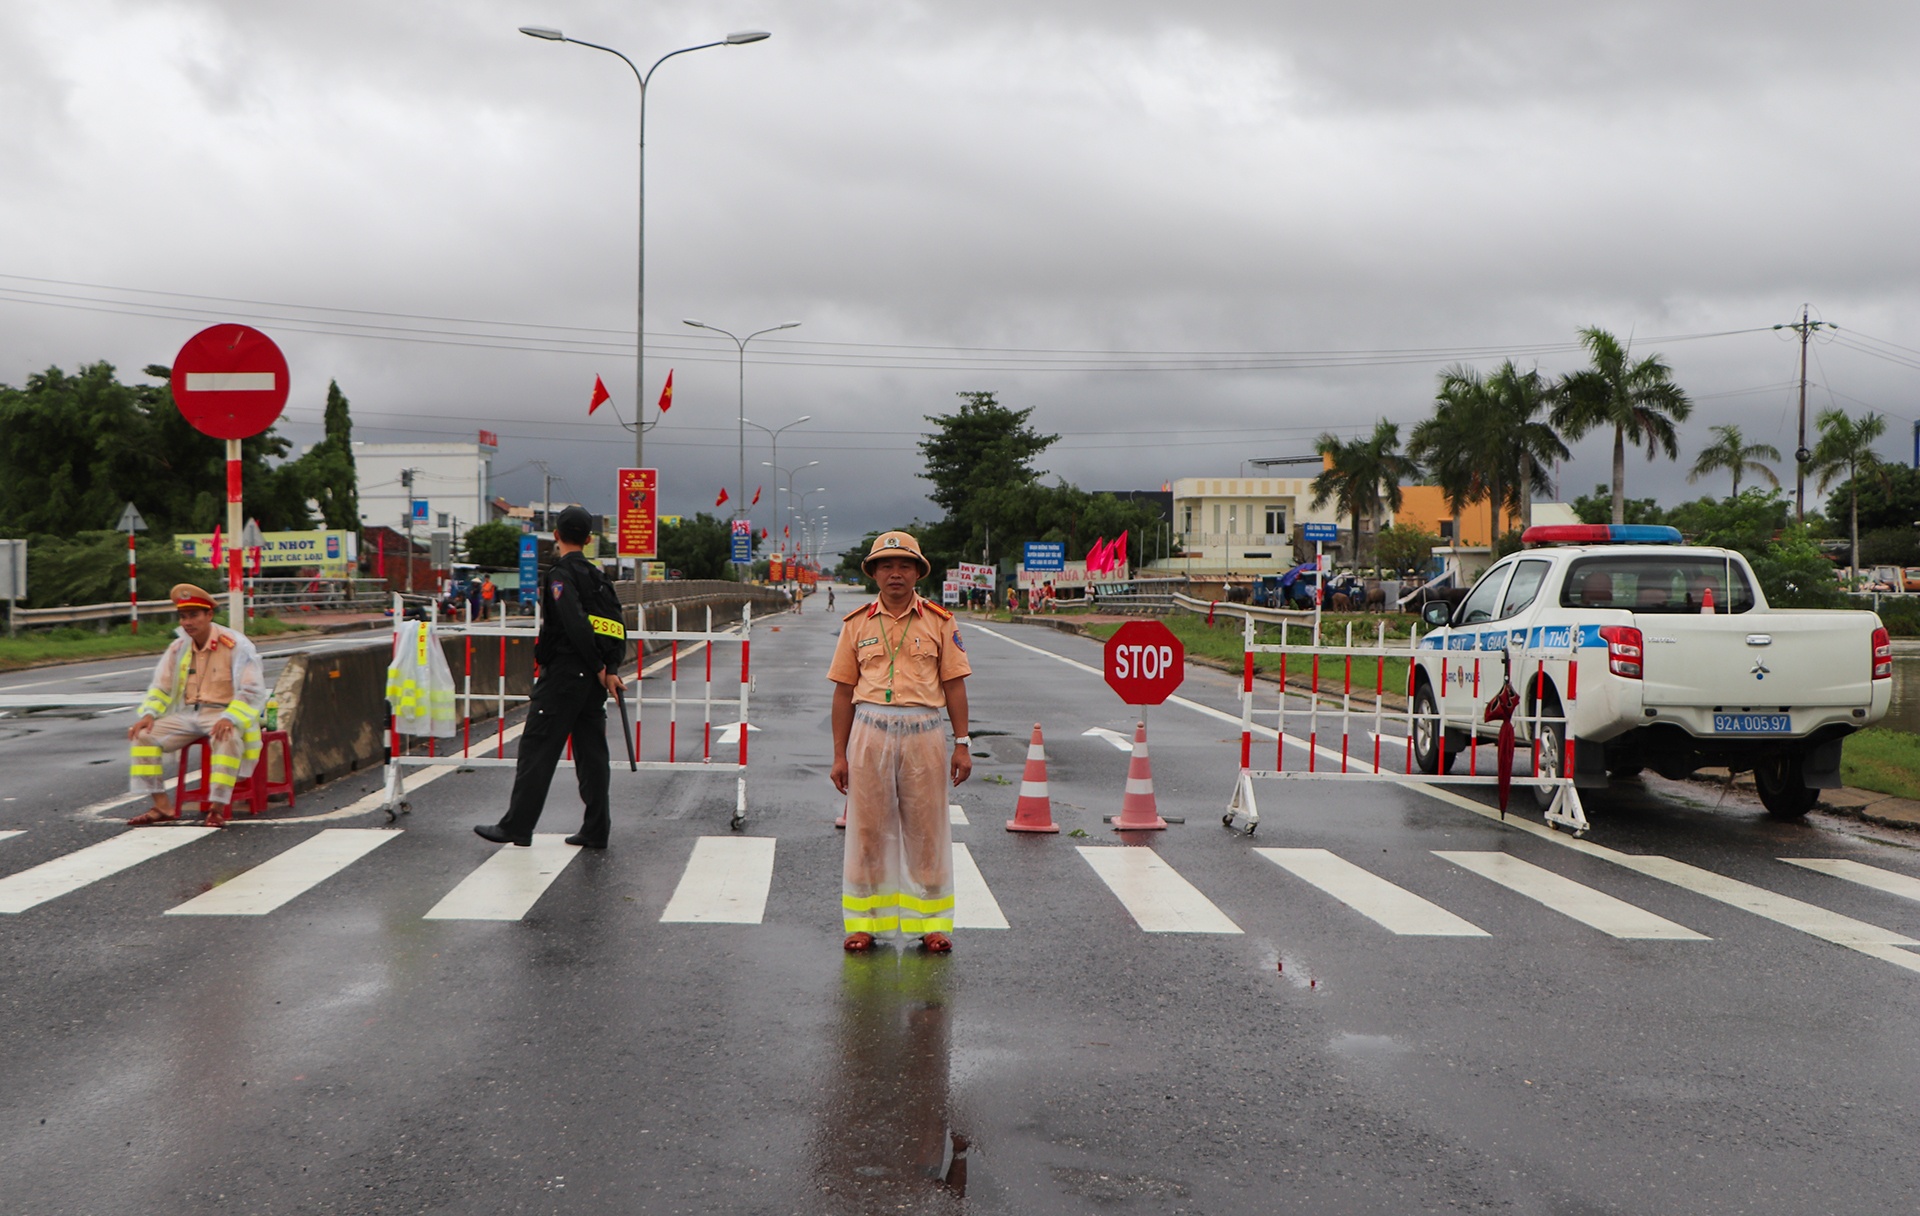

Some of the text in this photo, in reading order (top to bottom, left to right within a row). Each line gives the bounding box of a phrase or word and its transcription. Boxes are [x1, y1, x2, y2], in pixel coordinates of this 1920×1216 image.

[1549, 627, 1586, 647] THÔG
[1116, 644, 1173, 679] STOP
[1715, 715, 1788, 731] 92A-005.97
